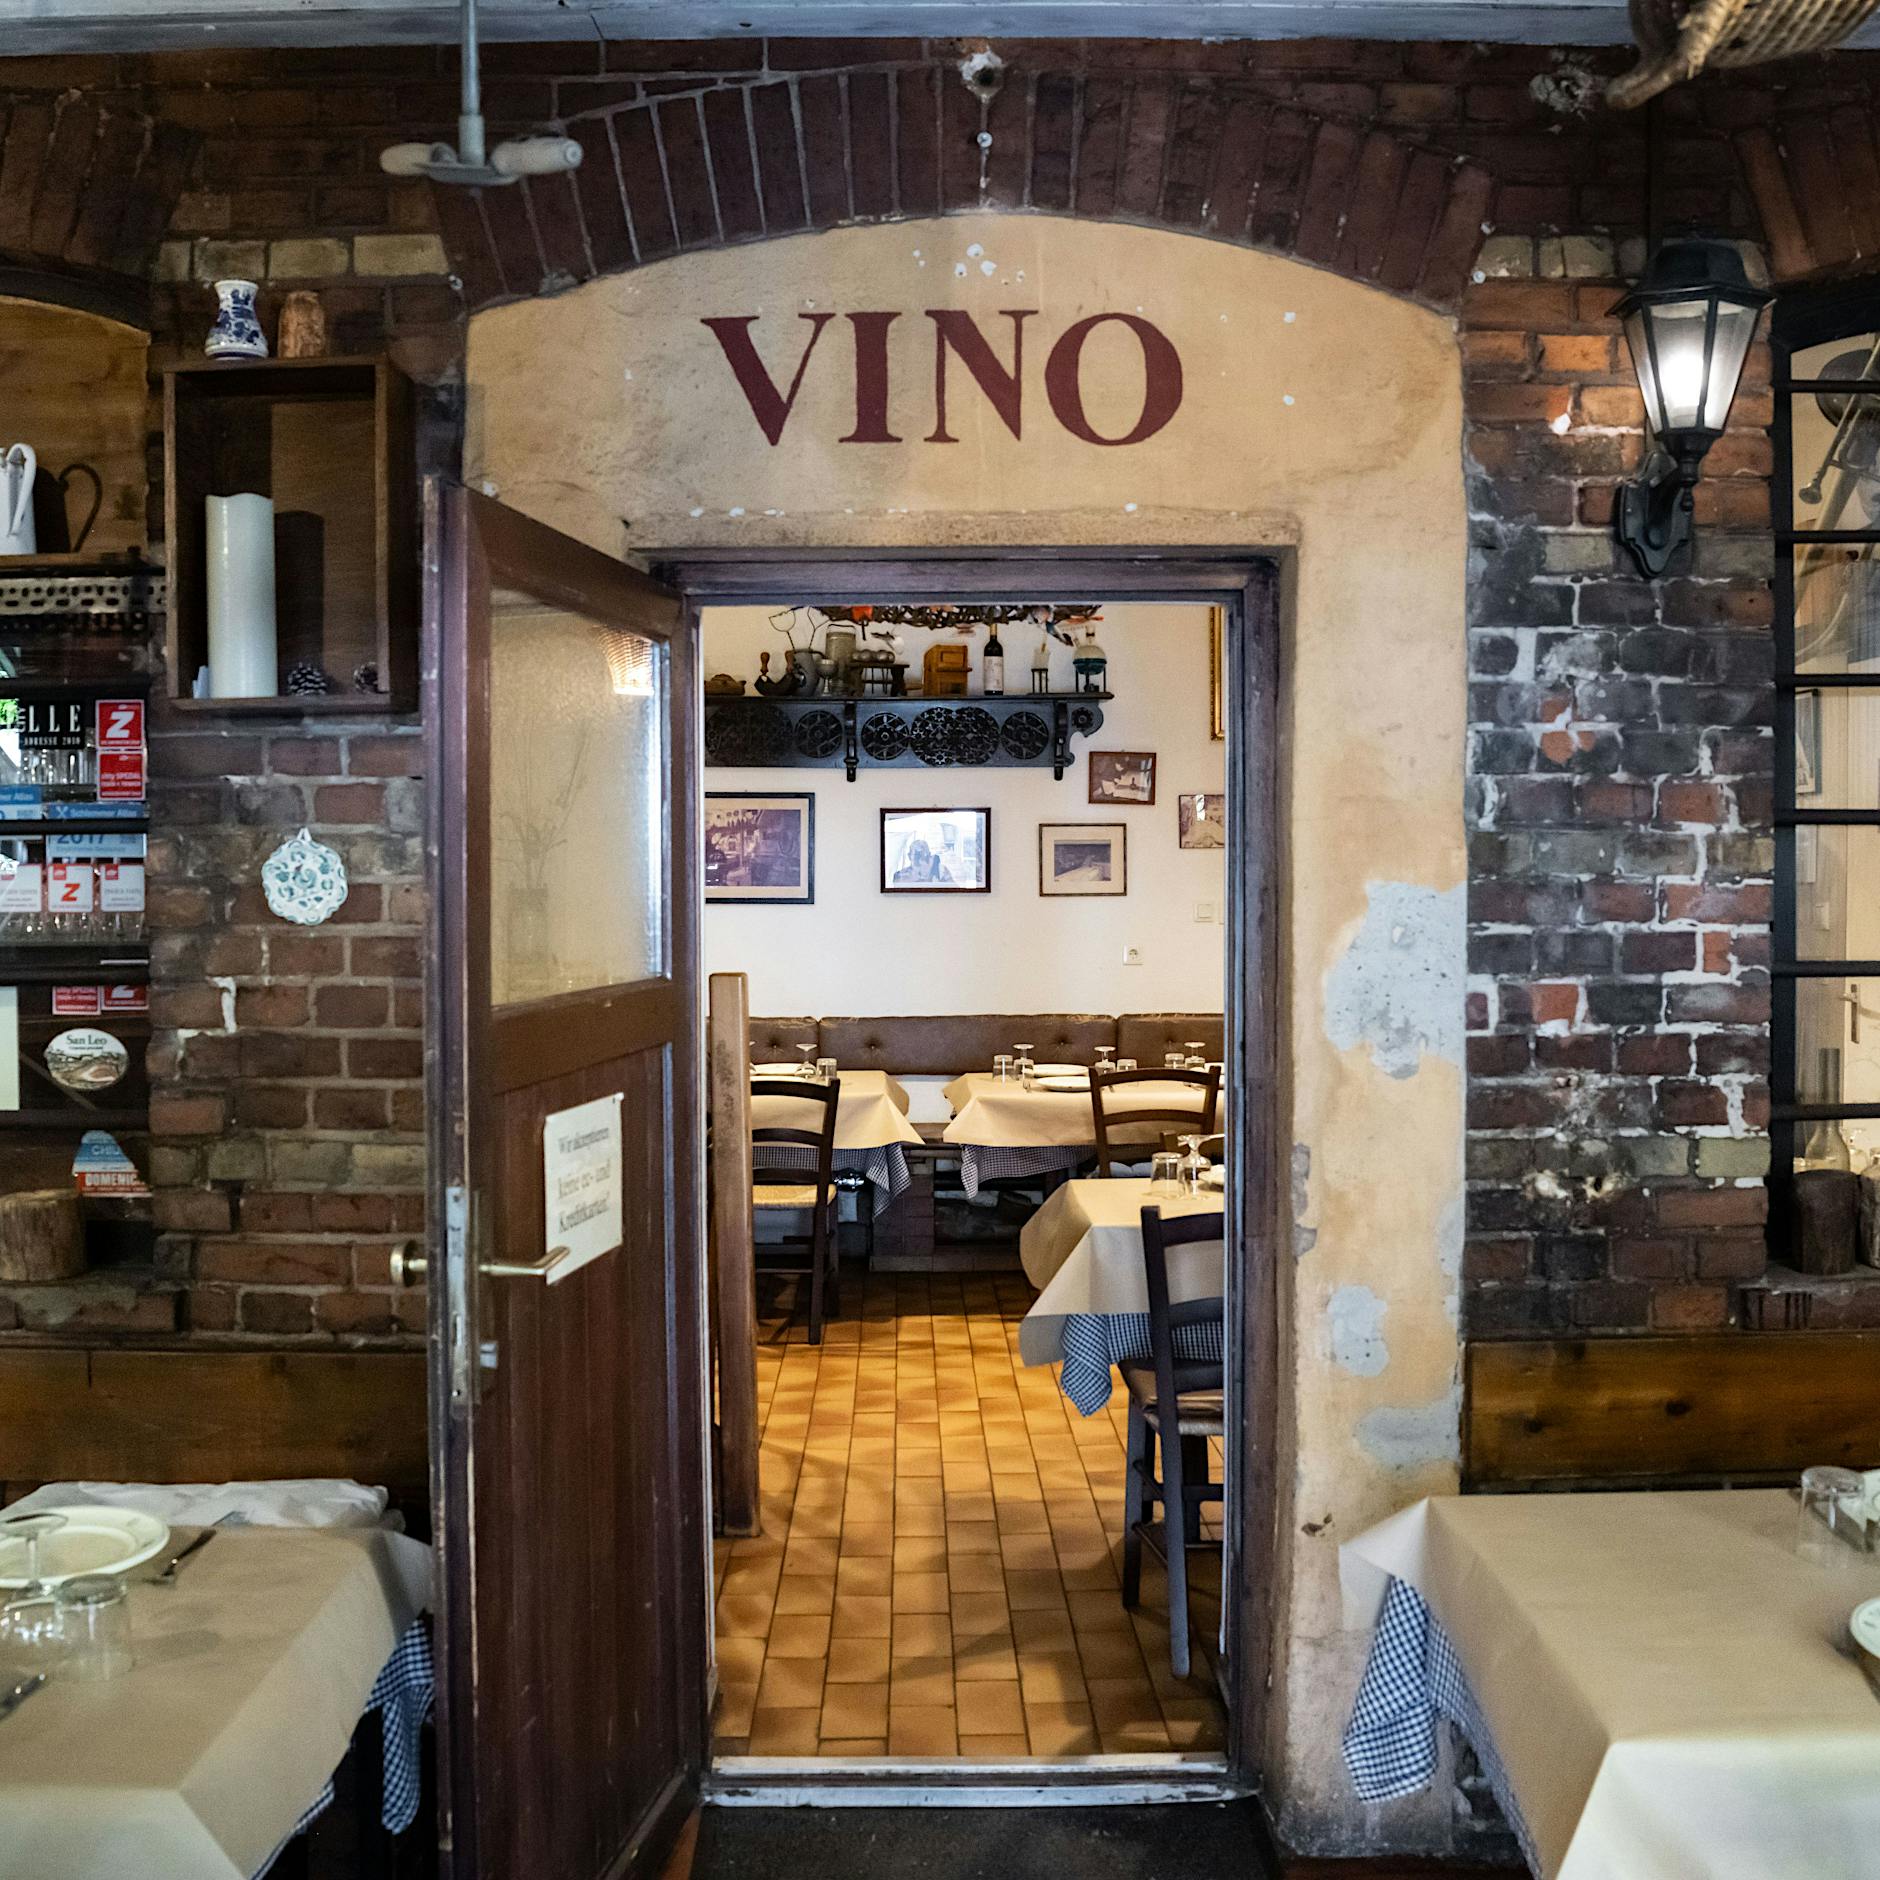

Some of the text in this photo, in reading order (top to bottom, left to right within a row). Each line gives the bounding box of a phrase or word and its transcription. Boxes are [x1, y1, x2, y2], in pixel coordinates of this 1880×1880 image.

[700, 310, 1183, 446] VINO
[106, 710, 135, 738] Z
[61, 883, 81, 902] Z
[66, 1034, 108, 1045] San Leo
